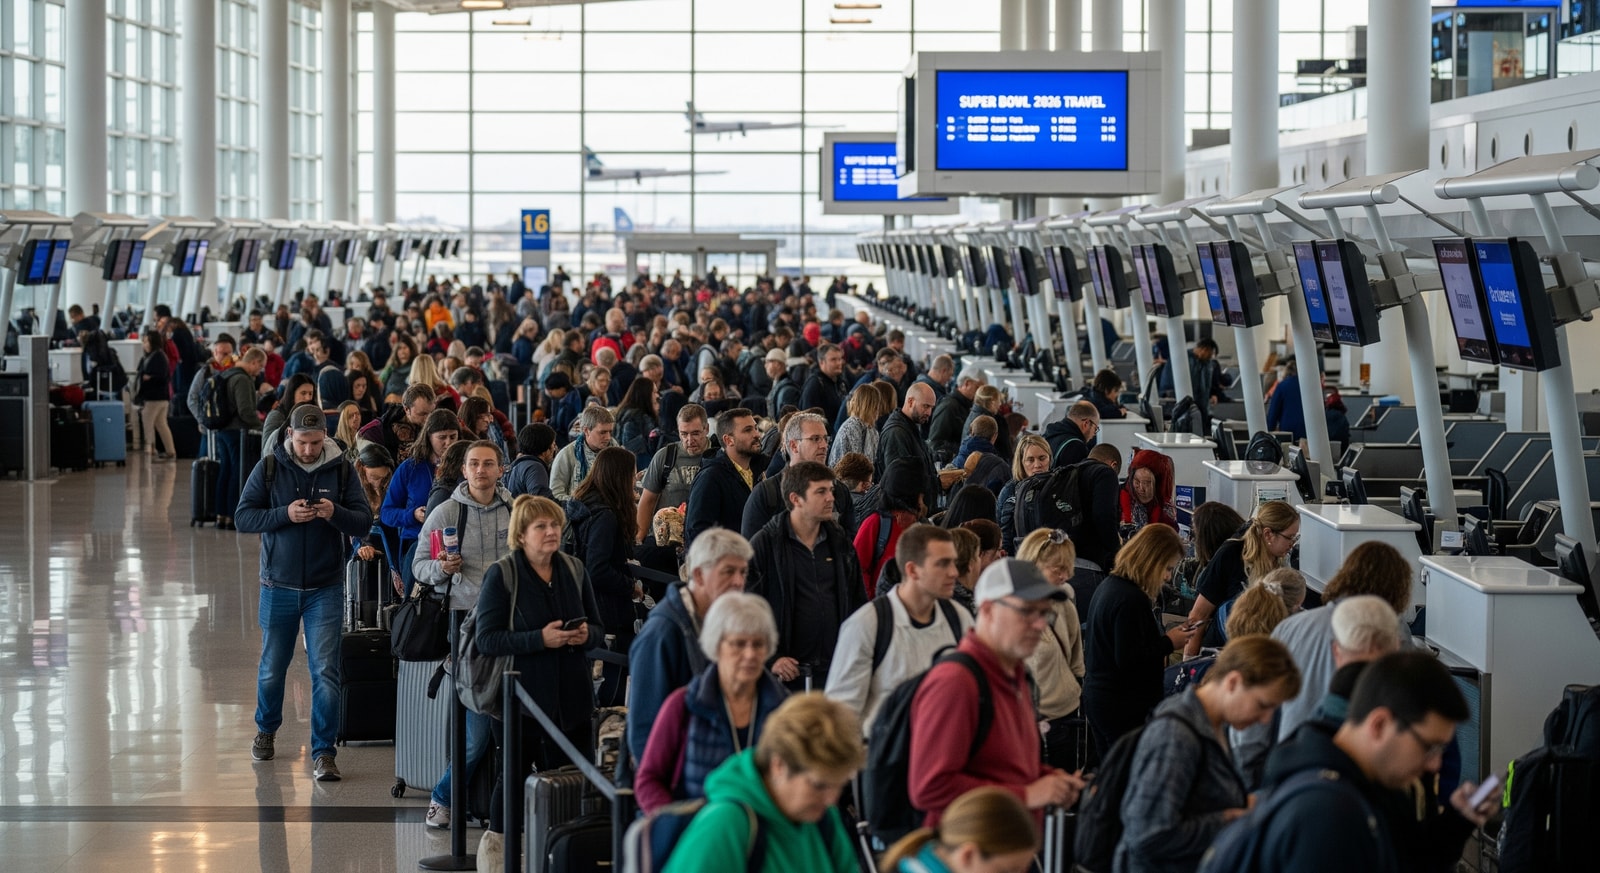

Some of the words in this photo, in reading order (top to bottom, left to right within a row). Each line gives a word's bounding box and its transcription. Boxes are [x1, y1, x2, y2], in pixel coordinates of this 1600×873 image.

[959, 95, 997, 108] SUPER
[998, 95, 1031, 108] BOWL
[1033, 95, 1062, 108] 2026
[1063, 95, 1106, 108] TRAVEL
[523, 213, 549, 233] 16
